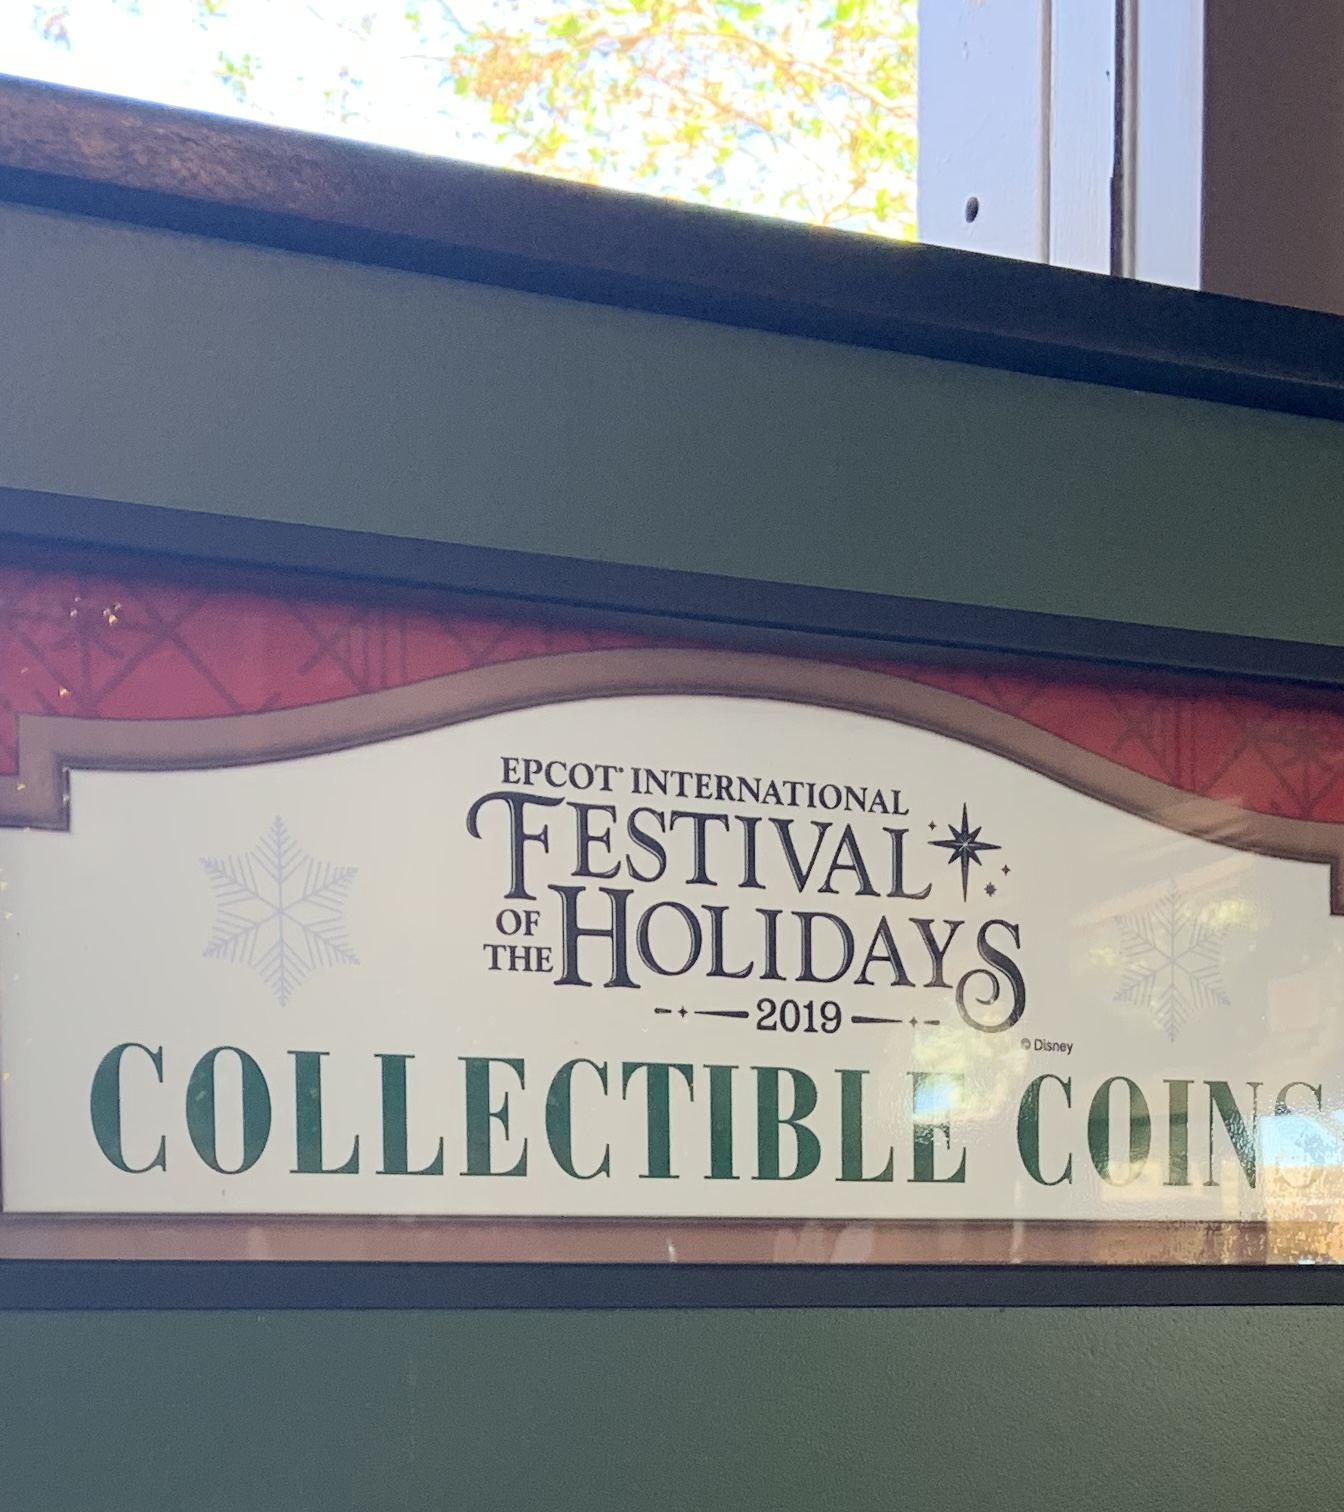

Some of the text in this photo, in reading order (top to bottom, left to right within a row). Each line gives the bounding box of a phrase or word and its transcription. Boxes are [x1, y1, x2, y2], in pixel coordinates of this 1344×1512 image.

[500, 756, 910, 816] EPCOT INTERNATIONAL
[466, 791, 933, 901] FESTIVAL
[496, 908, 541, 936] OF
[483, 943, 554, 973] THE
[547, 883, 1027, 1034] HOLIDAYS
[755, 998, 843, 1034] 2019
[1034, 1038, 1074, 1056] Disney
[90, 1041, 967, 1186] COLLECTIBLE
